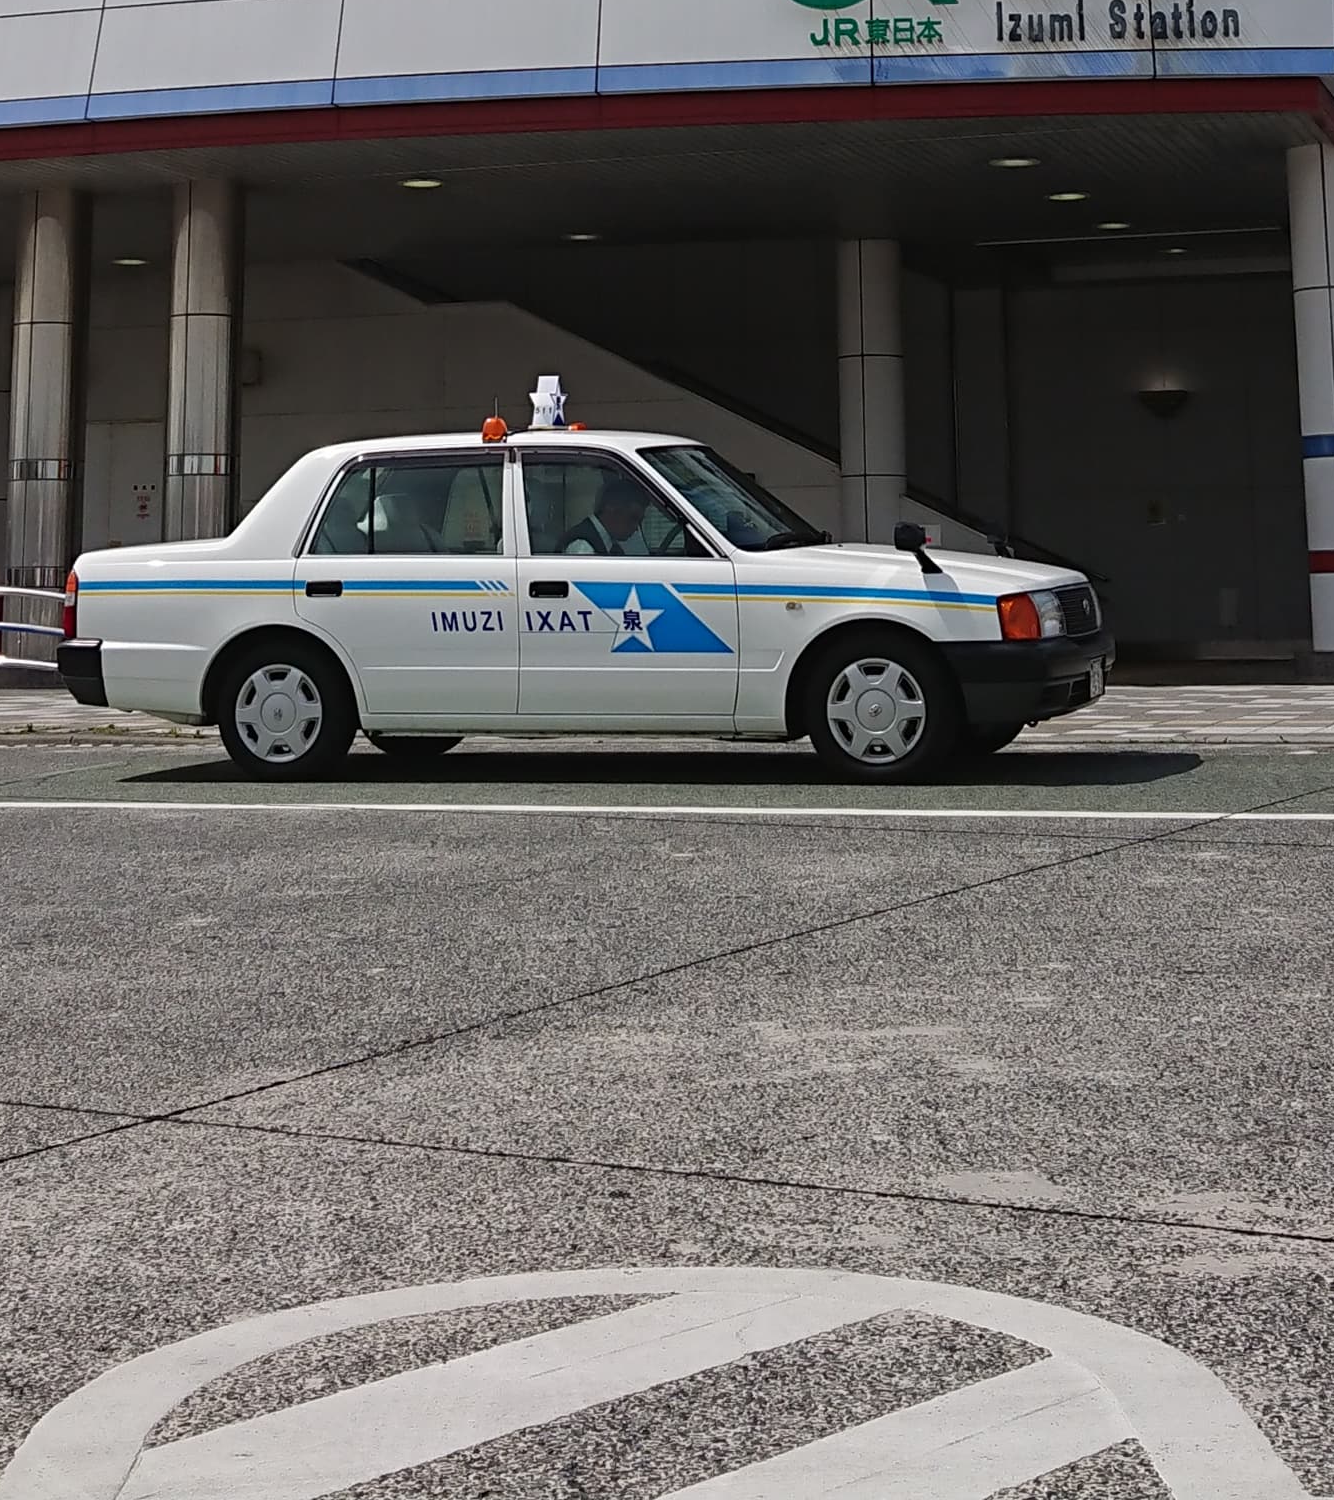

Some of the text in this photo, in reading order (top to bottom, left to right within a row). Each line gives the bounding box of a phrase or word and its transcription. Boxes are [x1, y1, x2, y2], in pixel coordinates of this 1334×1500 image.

[810, 17, 943, 47] JR東日本
[996, 0, 1085, 42] Izumi
[431, 611, 593, 632] IMUZI IXAT
[623, 610, 643, 631] 泉
